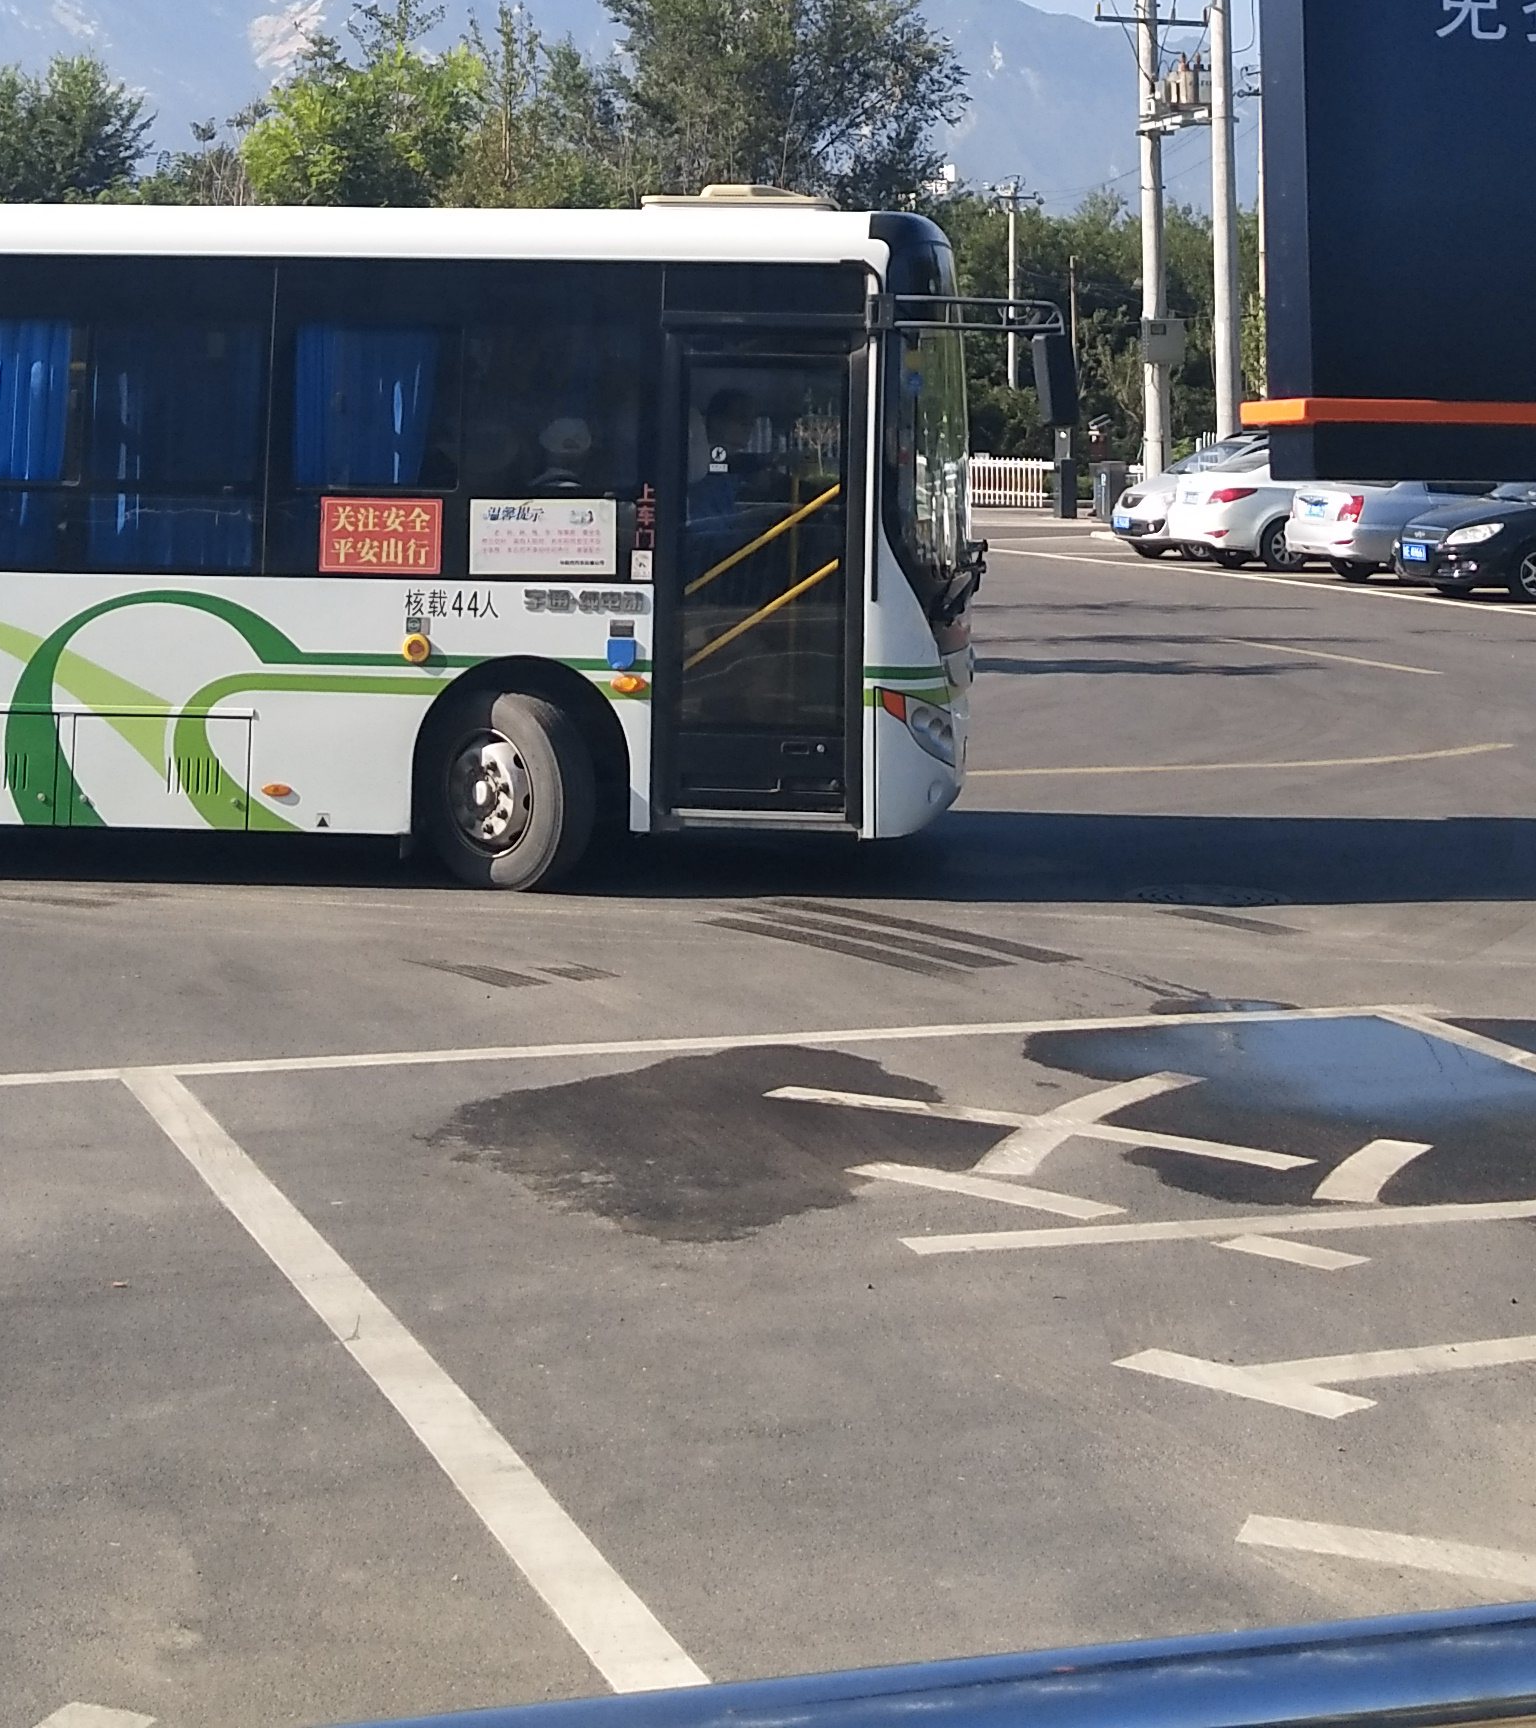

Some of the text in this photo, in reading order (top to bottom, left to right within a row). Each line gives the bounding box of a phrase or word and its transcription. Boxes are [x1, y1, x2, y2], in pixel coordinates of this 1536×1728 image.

[331, 506, 432, 532] 关注安全
[636, 483, 656, 549] 上车门
[330, 537, 430, 565] 平安出行
[405, 588, 499, 619] 核载44人
